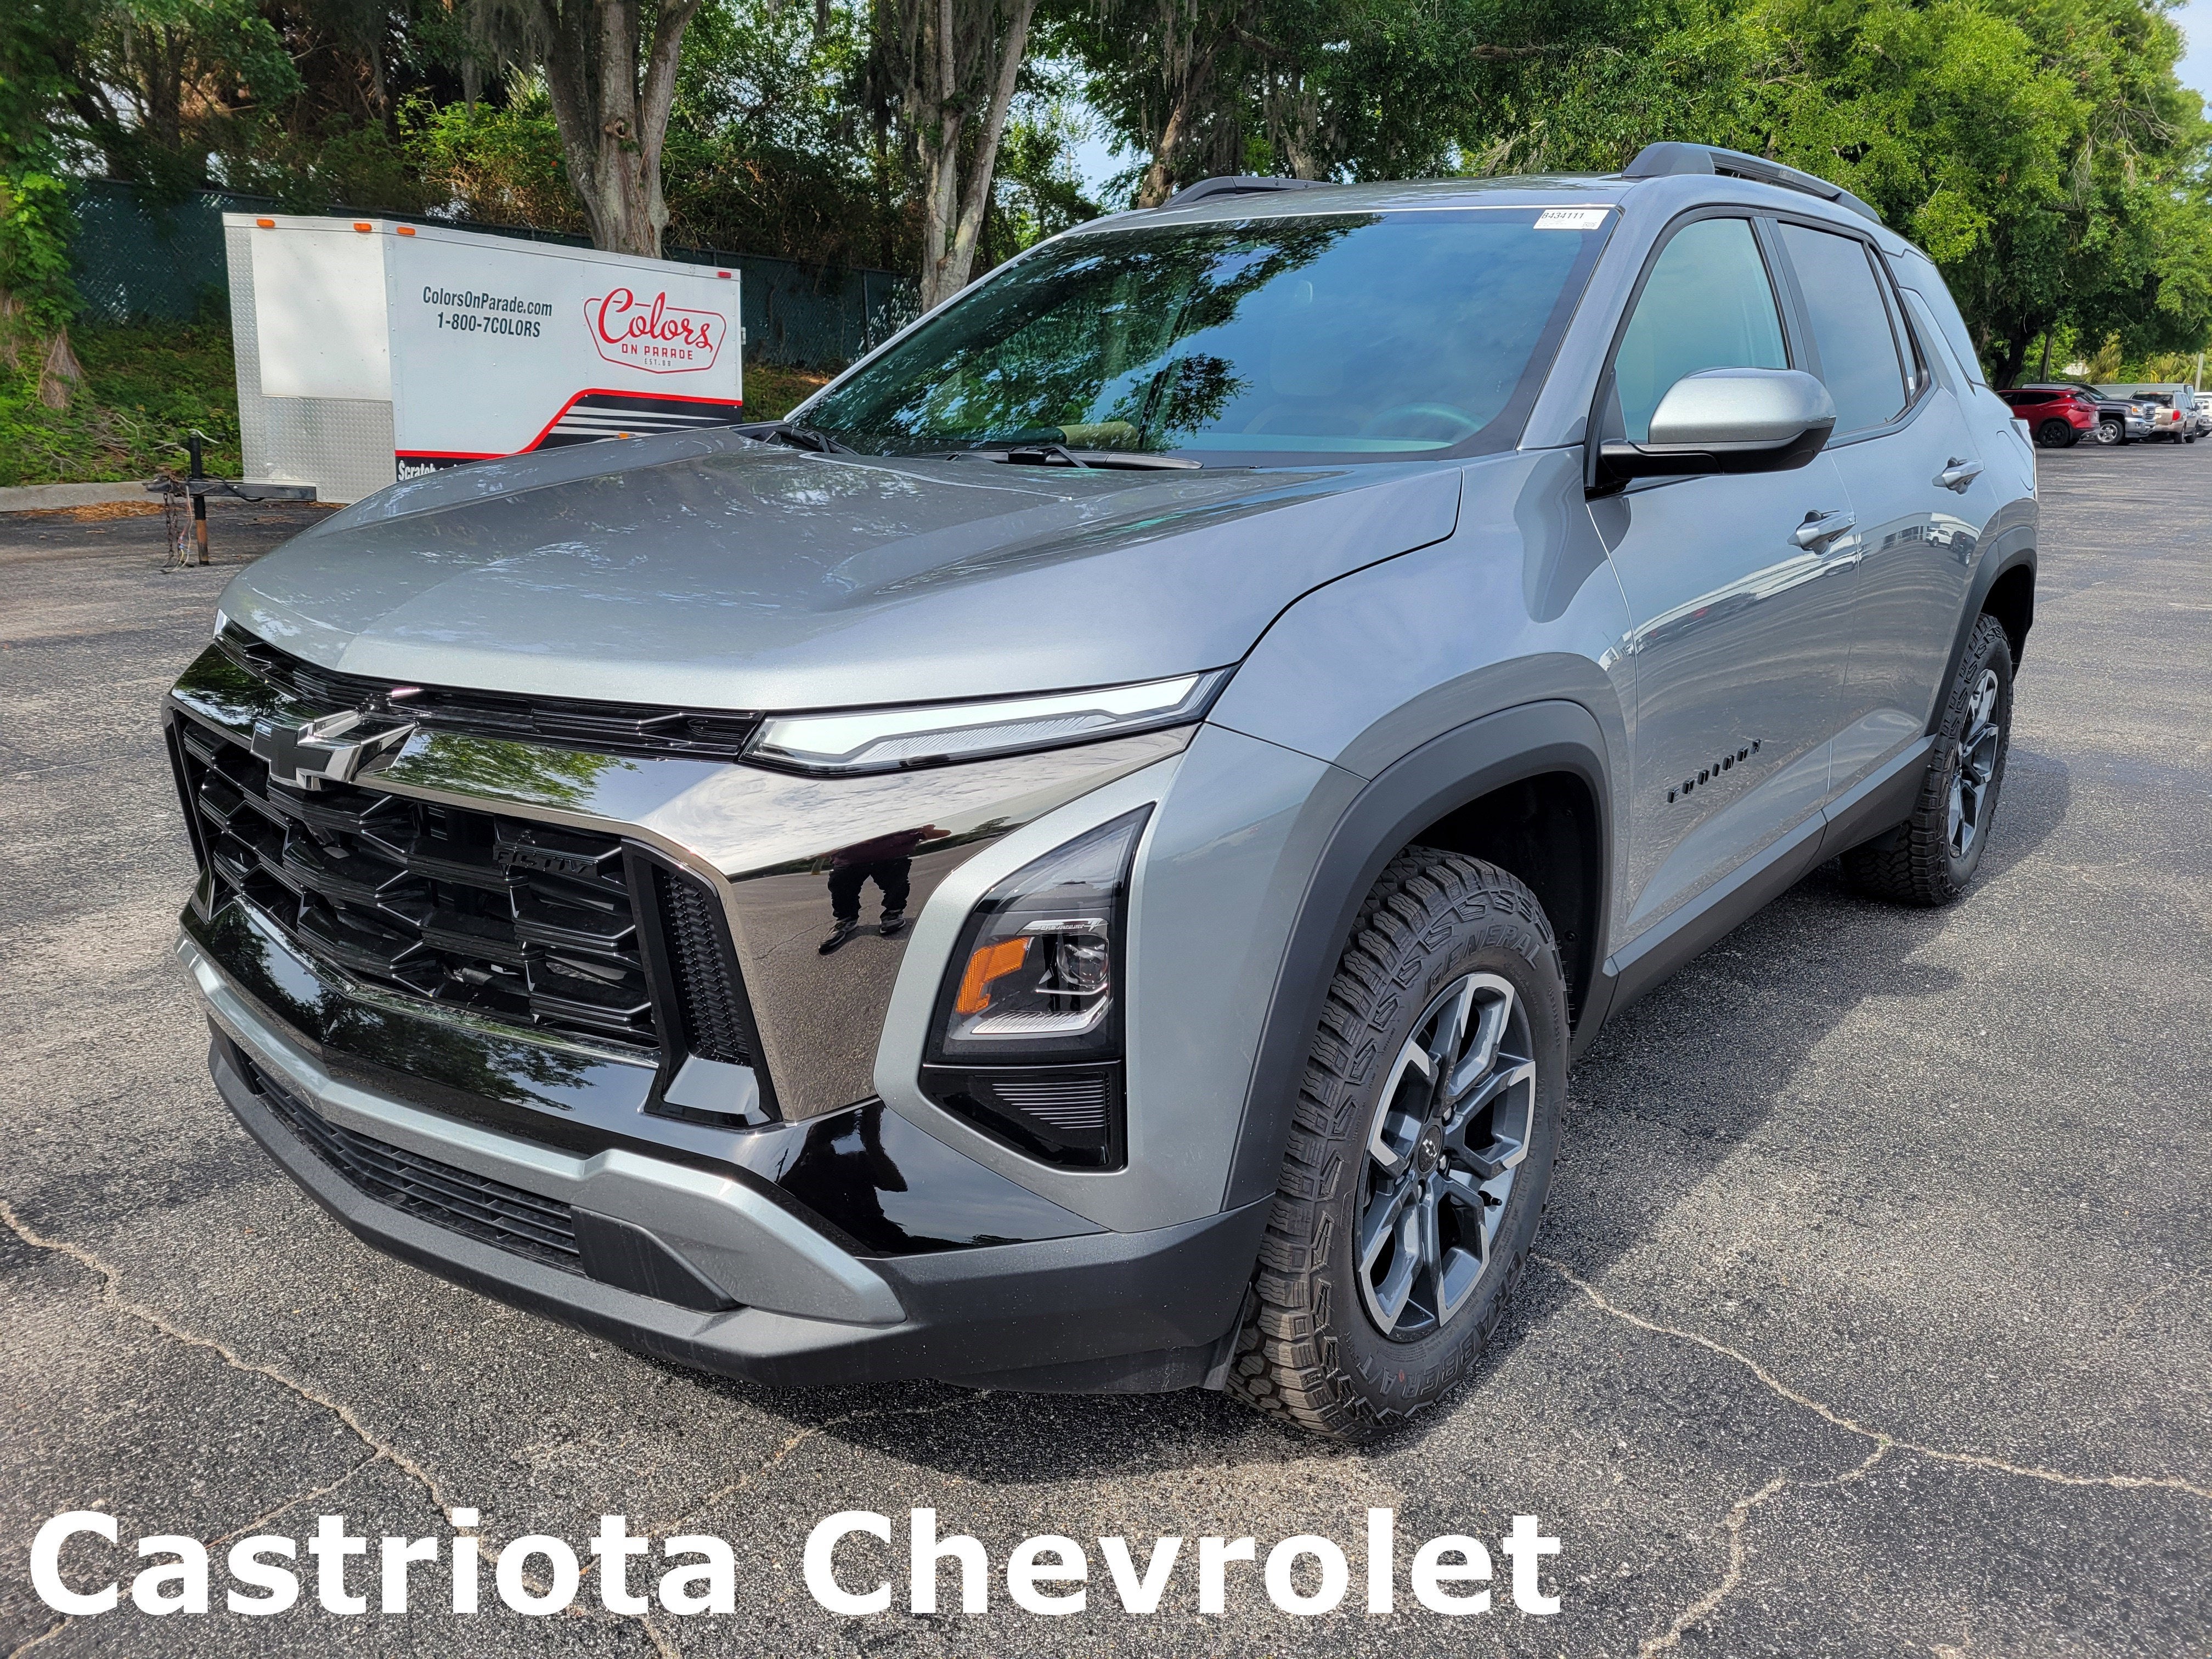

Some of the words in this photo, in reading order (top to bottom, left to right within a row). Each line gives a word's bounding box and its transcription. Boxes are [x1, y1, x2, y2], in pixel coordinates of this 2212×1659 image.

[423, 286, 552, 317] ColorsOnParade.com
[438, 312, 541, 337] 1-800-7COLORS
[598, 287, 713, 353] Colors
[622, 343, 637, 354] ON
[644, 346, 693, 360] PARADE
[1423, 924, 1541, 1002] GENERAL
[1401, 1250, 1522, 1400] GRABBER
